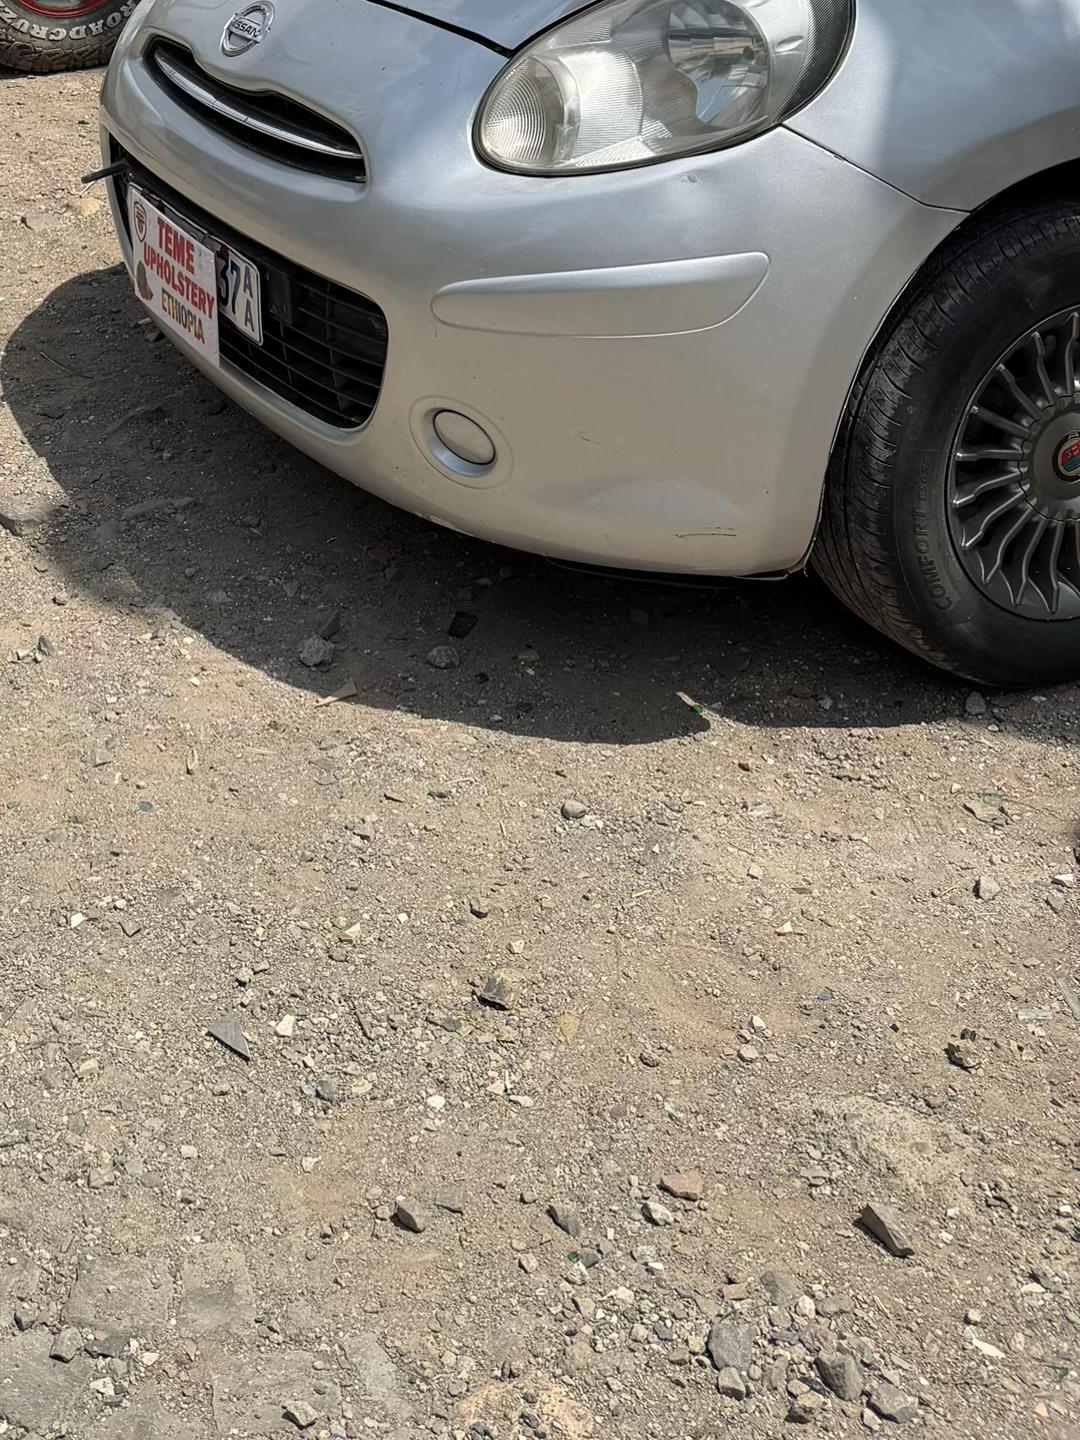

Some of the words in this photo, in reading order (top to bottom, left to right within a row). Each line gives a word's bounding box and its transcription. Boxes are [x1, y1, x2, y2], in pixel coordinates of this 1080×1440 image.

[157, 216, 195, 275] TEME
[143, 242, 215, 320] UPHOLSTERY
[161, 287, 205, 345] ETHIOPIA
[912, 507, 952, 610] COMFORT
